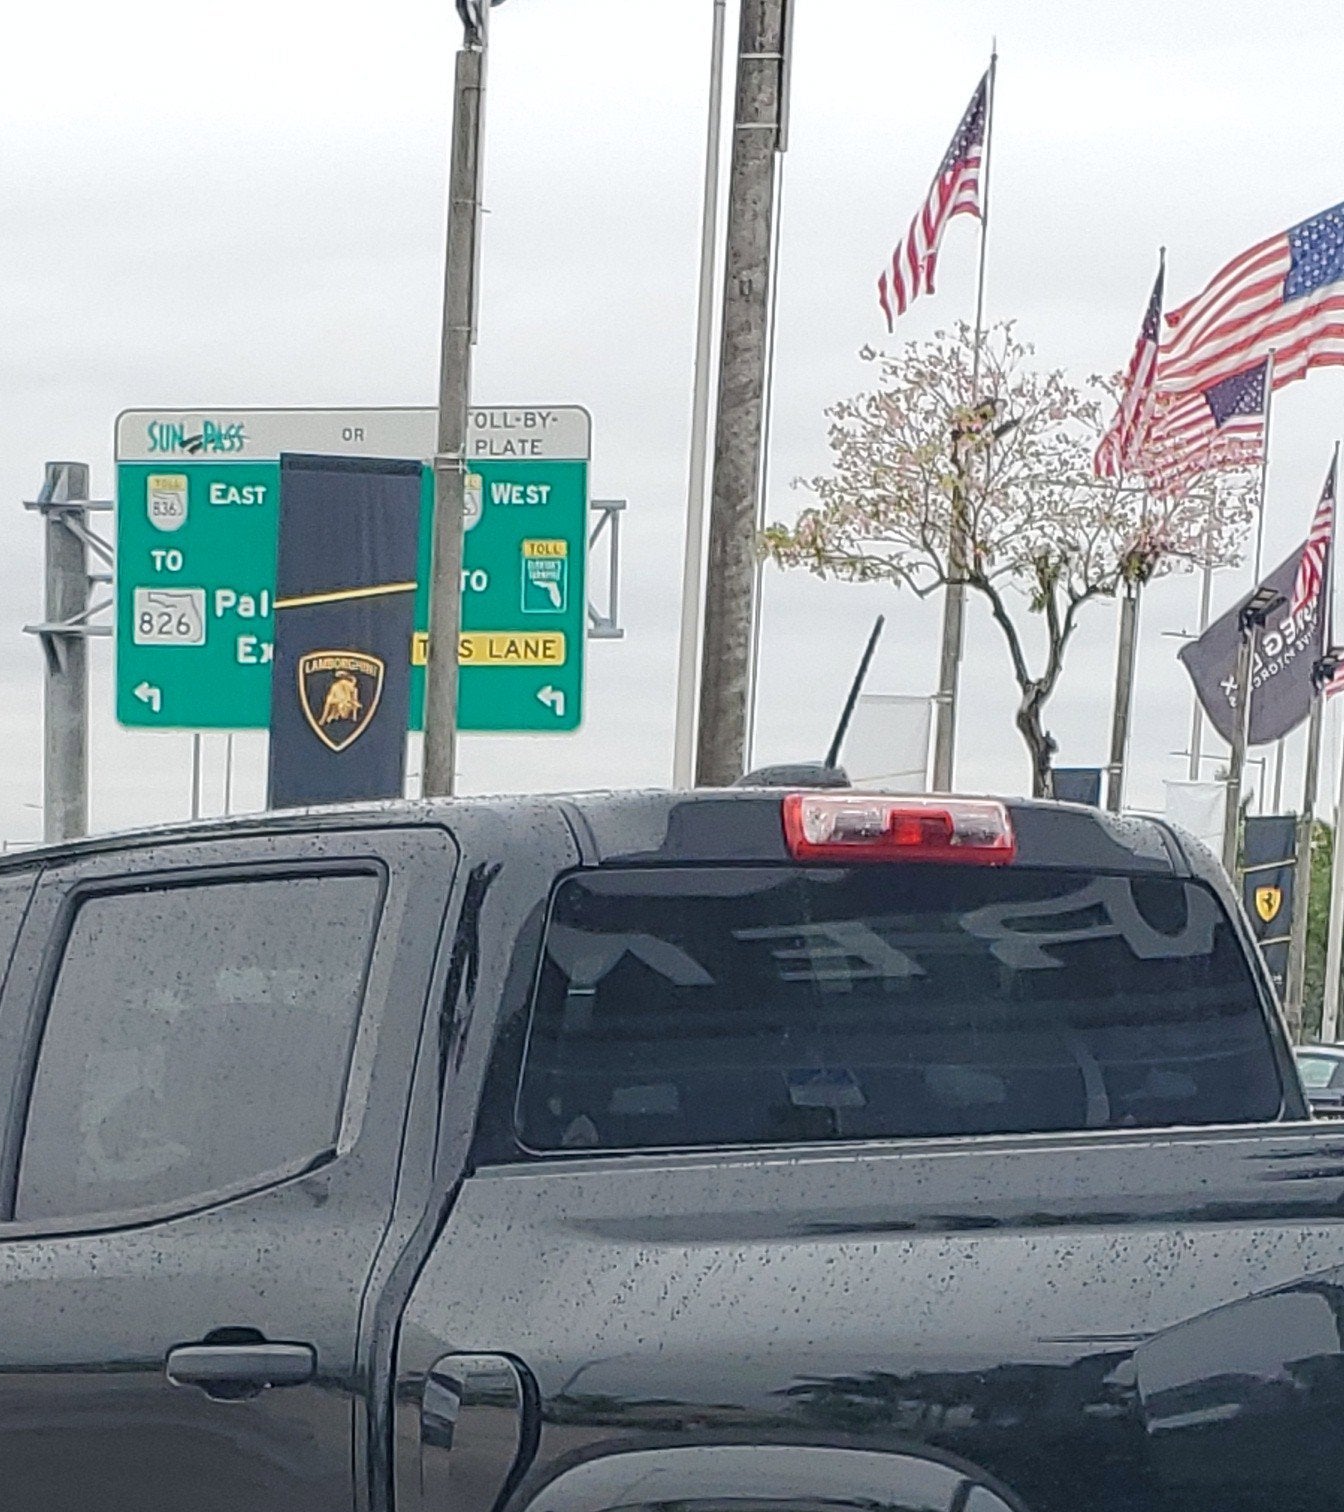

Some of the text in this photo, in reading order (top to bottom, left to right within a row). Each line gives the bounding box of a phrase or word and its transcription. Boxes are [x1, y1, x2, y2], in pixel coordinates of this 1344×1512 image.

[342, 428, 364, 442] OR
[475, 439, 543, 456] PLATE
[209, 482, 267, 505] EAST
[490, 482, 552, 505] WEST
[529, 543, 562, 555] TOLL
[150, 549, 184, 572] TO
[139, 611, 191, 636] 826
[418, 638, 557, 659] TS LANE
